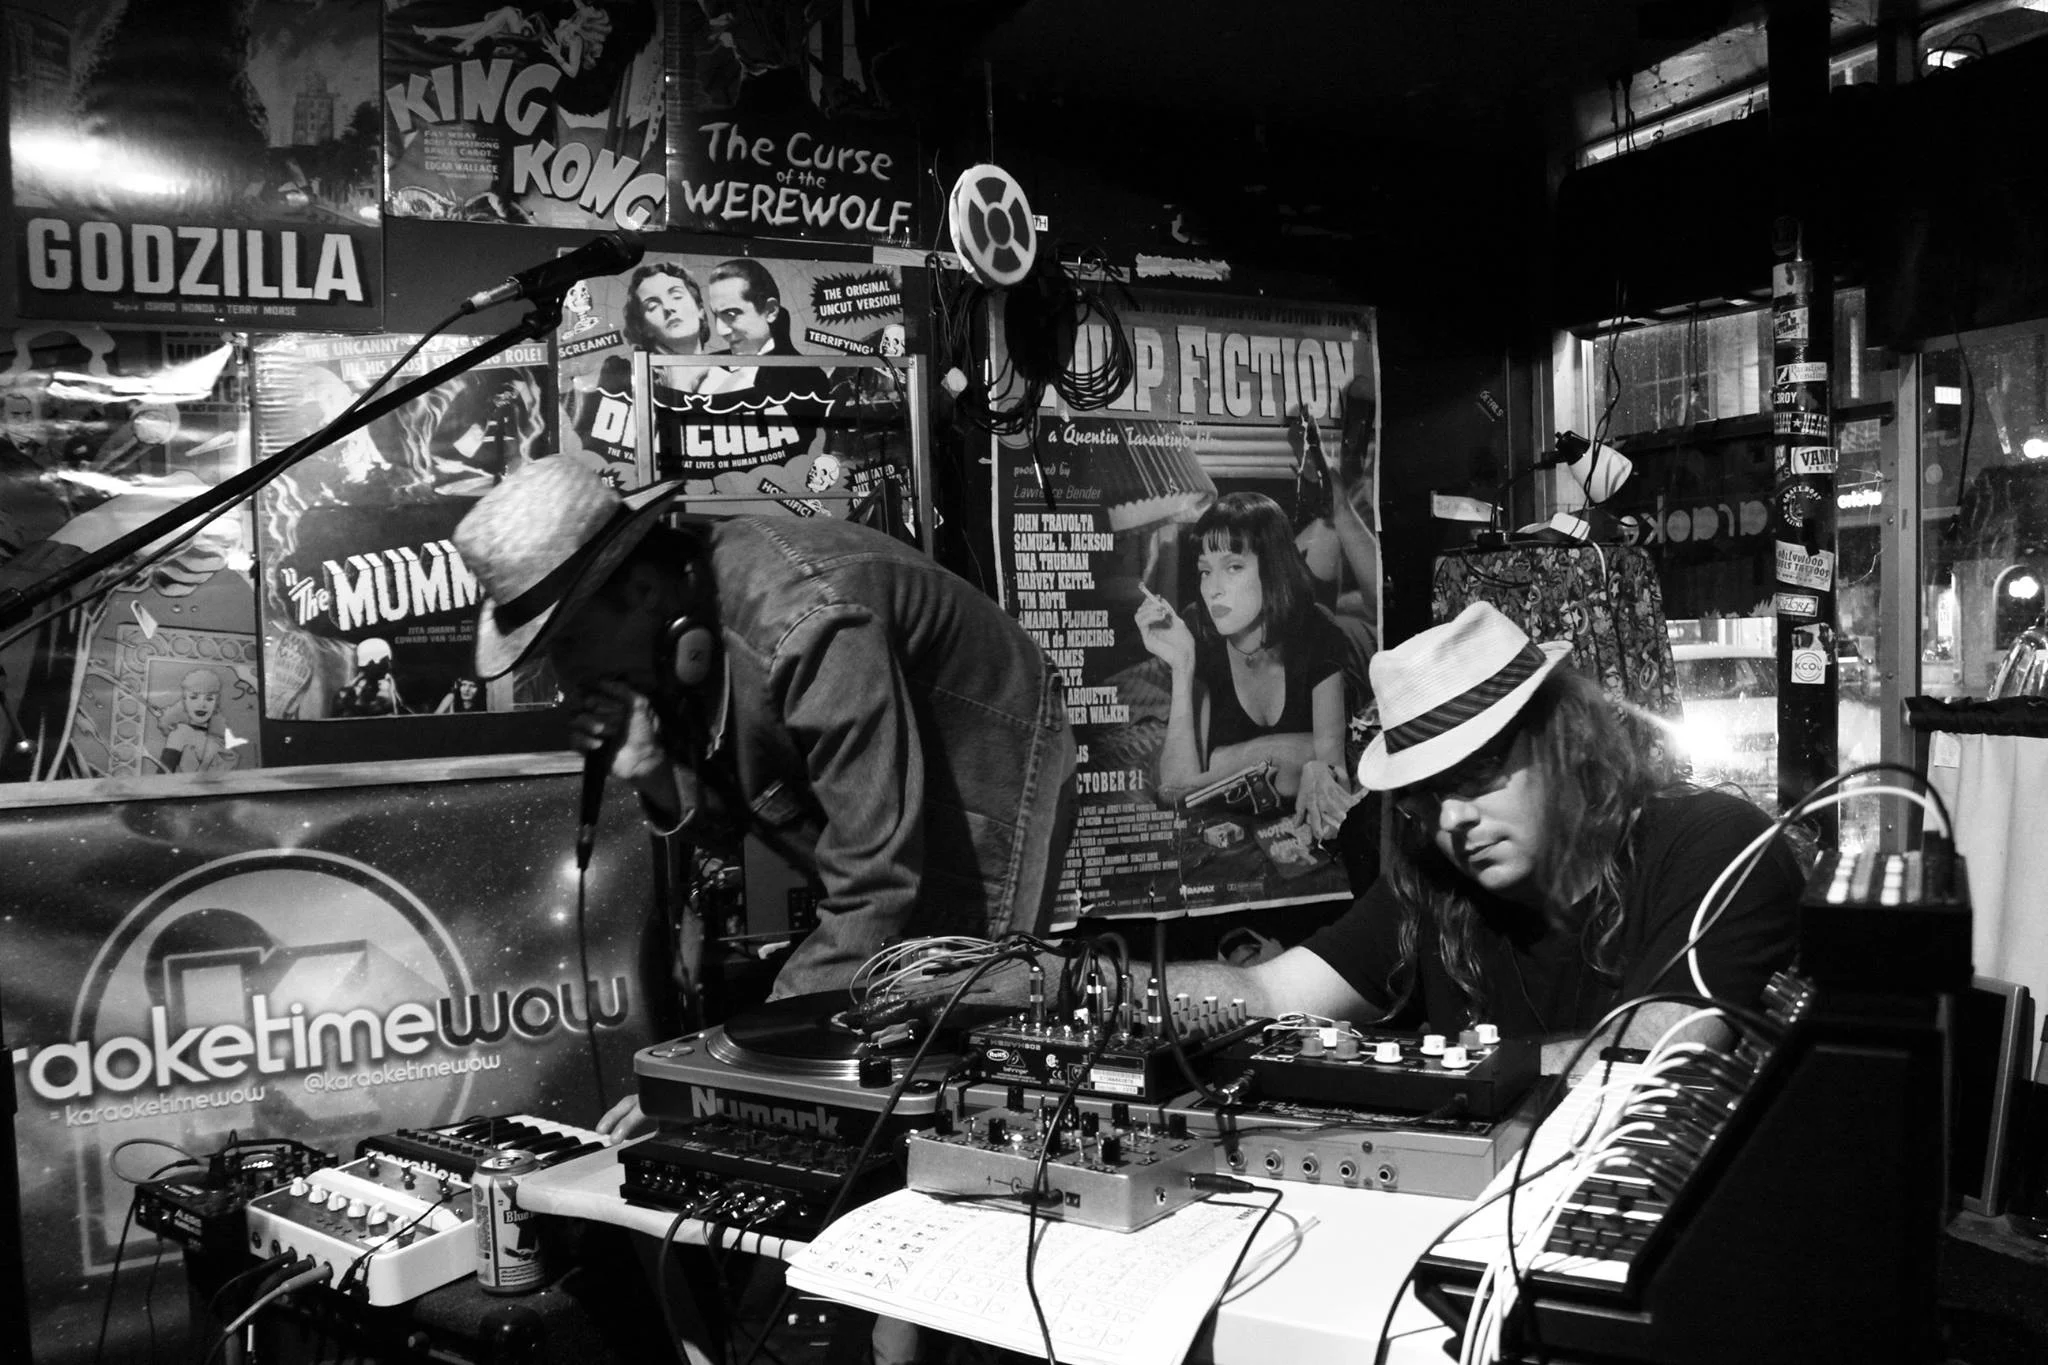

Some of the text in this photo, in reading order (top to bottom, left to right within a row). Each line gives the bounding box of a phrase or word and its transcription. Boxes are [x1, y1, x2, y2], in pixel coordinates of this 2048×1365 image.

[385, 57, 562, 135] KING
[698, 121, 894, 181] The Curse
[512, 138, 667, 231] KONG
[776, 168, 827, 189] of the
[681, 179, 913, 236] WEREWOLF
[26, 217, 363, 302] GODZILLA
[823, 281, 890, 300] THE ORIGINAL
[819, 292, 901, 317] UNCUT VERSION!
[331, 338, 399, 355] UNCANNY
[559, 333, 618, 357] SCREAMY!
[809, 332, 875, 354] TERRIFYING!
[505, 347, 543, 364] ROLE!
[1176, 324, 1356, 421] FICTION
[591, 396, 801, 458] DCULA
[1047, 430, 1058, 443] a
[1062, 423, 1121, 447] Quentin
[1124, 426, 1191, 447] Tarantino
[607, 446, 622, 458] THE
[695, 460, 716, 470] LIVES
[718, 460, 730, 469] ON
[732, 455, 758, 468] HUMAN
[760, 449, 787, 464] BLOOD!
[1059, 461, 1071, 478] by
[1065, 484, 1102, 500] Bender
[1013, 513, 1095, 532] JOHN TRAVOLTA
[1013, 533, 1114, 552] SAMUEL L. JACKSON
[1014, 552, 1090, 572] UMA THURMAN
[323, 539, 486, 632] MUMM
[1016, 572, 1096, 590] HARVEY KEITEL
[1017, 591, 1067, 609] TIM ROTH
[1017, 609, 1110, 629] AMANDA PLUMMER
[1052, 630, 1065, 648] de
[1066, 628, 1115, 648] MEDEIROS
[1067, 686, 1118, 707] ARQUETTE
[1089, 704, 1130, 724] WALKEN
[1076, 769, 1144, 795] CTOBER 21
[12, 976, 629, 1101] aoketimewow
[303, 1051, 501, 1095] @karaoketimewow
[65, 1085, 266, 1129] karaoketimewow
[690, 1086, 840, 1138] Numark
[505, 1211, 530, 1224] Blue
